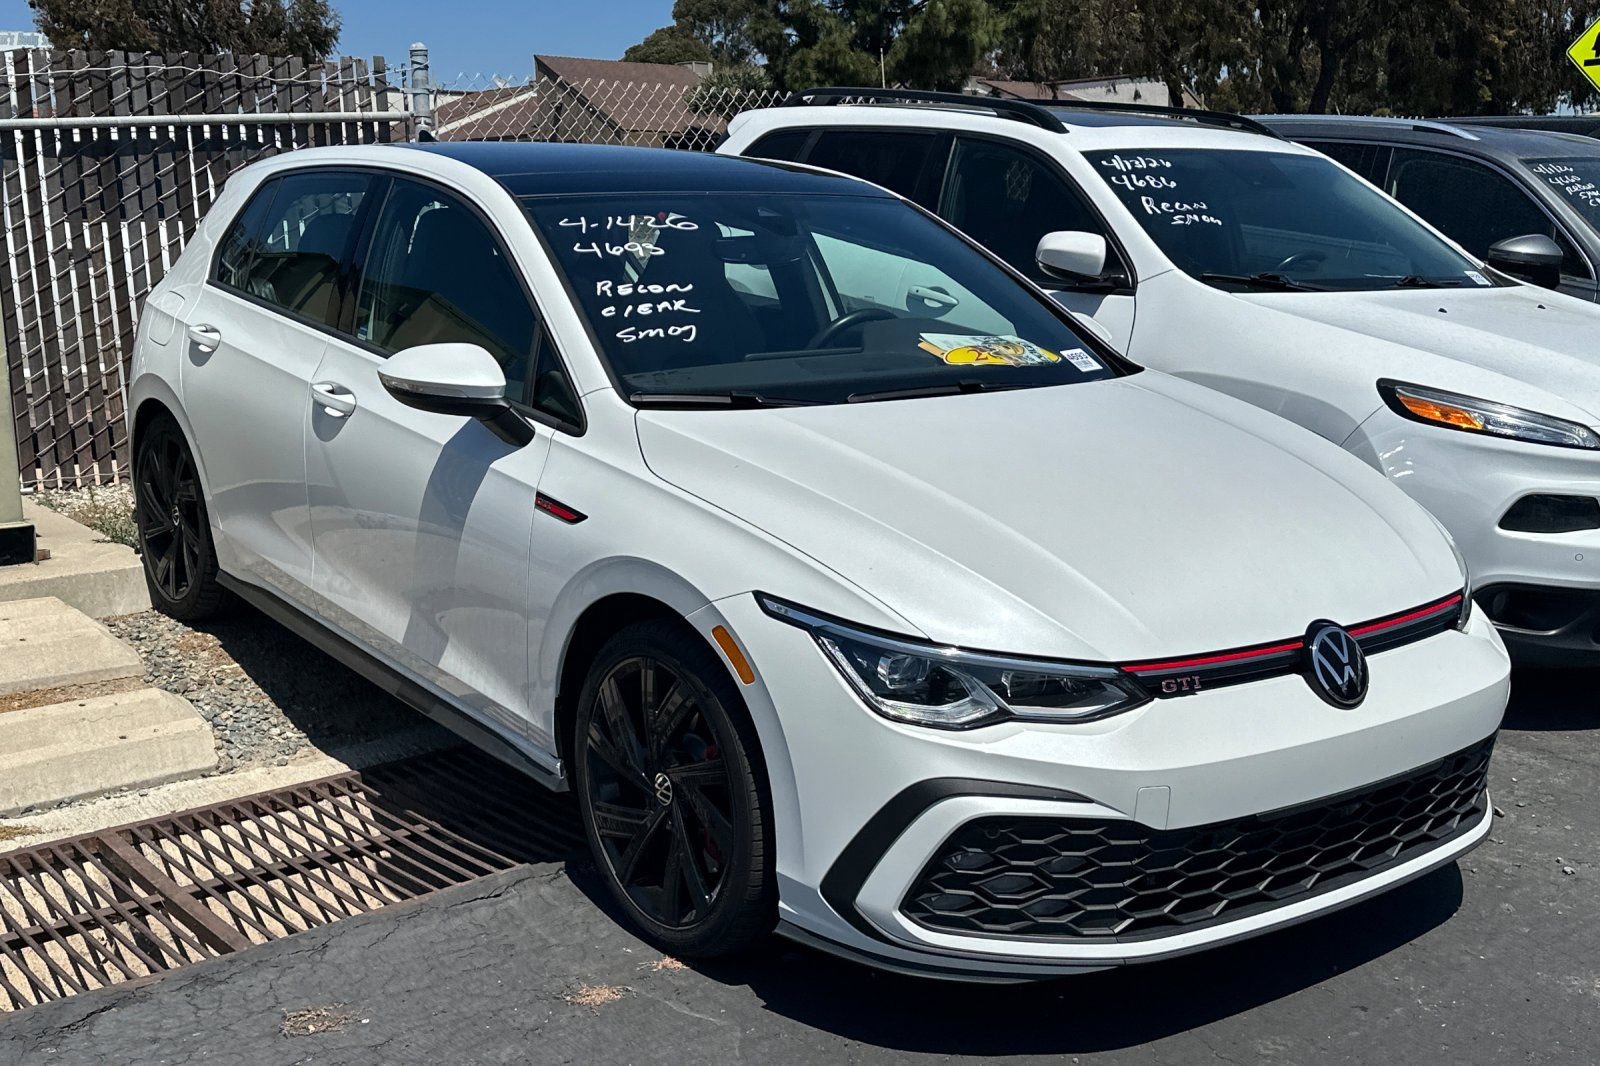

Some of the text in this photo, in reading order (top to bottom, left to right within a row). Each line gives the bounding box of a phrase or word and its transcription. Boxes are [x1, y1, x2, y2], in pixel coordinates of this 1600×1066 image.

[1111, 174, 1177, 191] 4686
[573, 241, 665, 258] 4693
[1161, 674, 1202, 694] GTI
